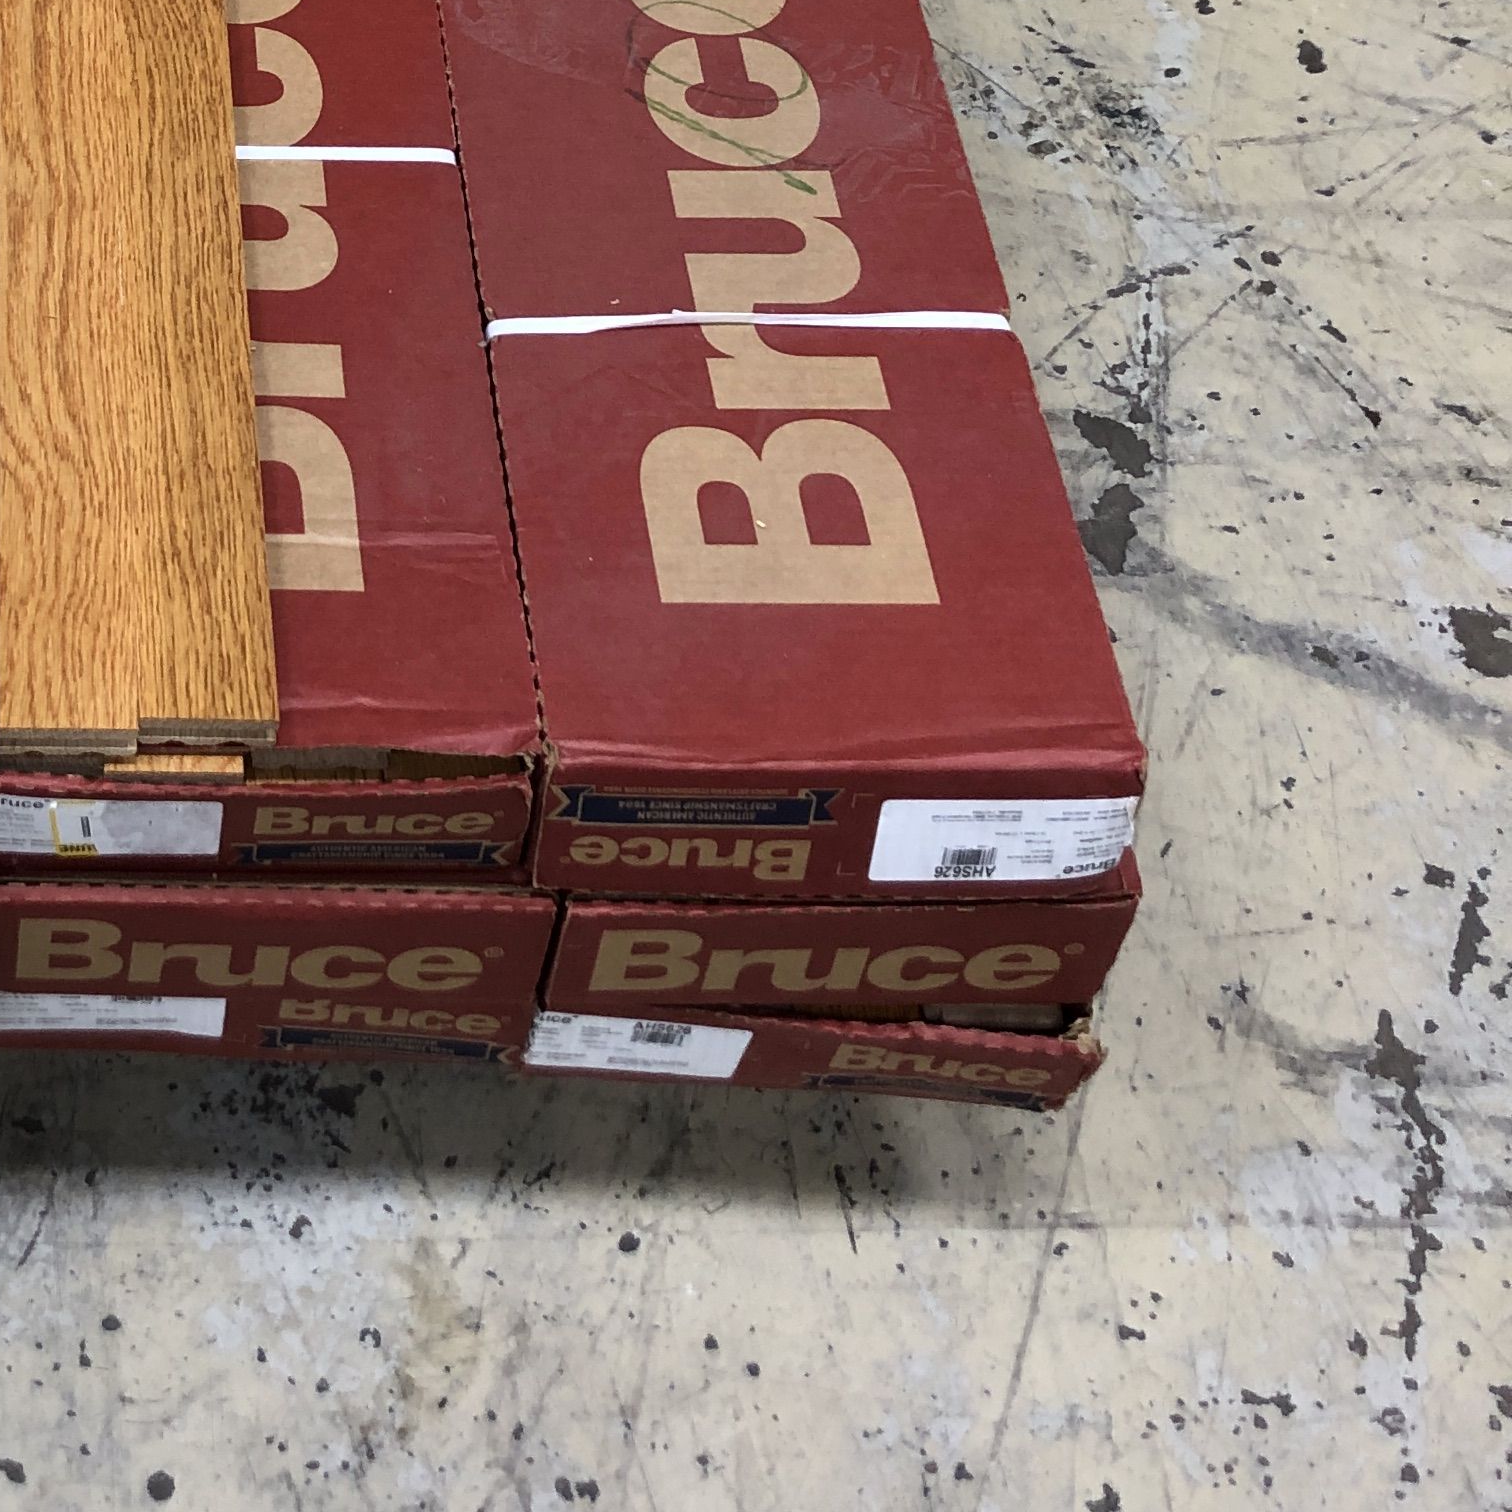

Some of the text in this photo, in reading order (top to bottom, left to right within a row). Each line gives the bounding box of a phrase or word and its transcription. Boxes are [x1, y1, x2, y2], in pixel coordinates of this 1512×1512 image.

[254, 806, 494, 837] Bruce
[568, 834, 812, 881] Bruce
[934, 865, 996, 878] AHS626
[1062, 858, 1116, 876] Bruce
[15, 916, 483, 989] Bruce
[588, 928, 1061, 991] Bruce
[829, 1042, 1052, 1088] Bruce
